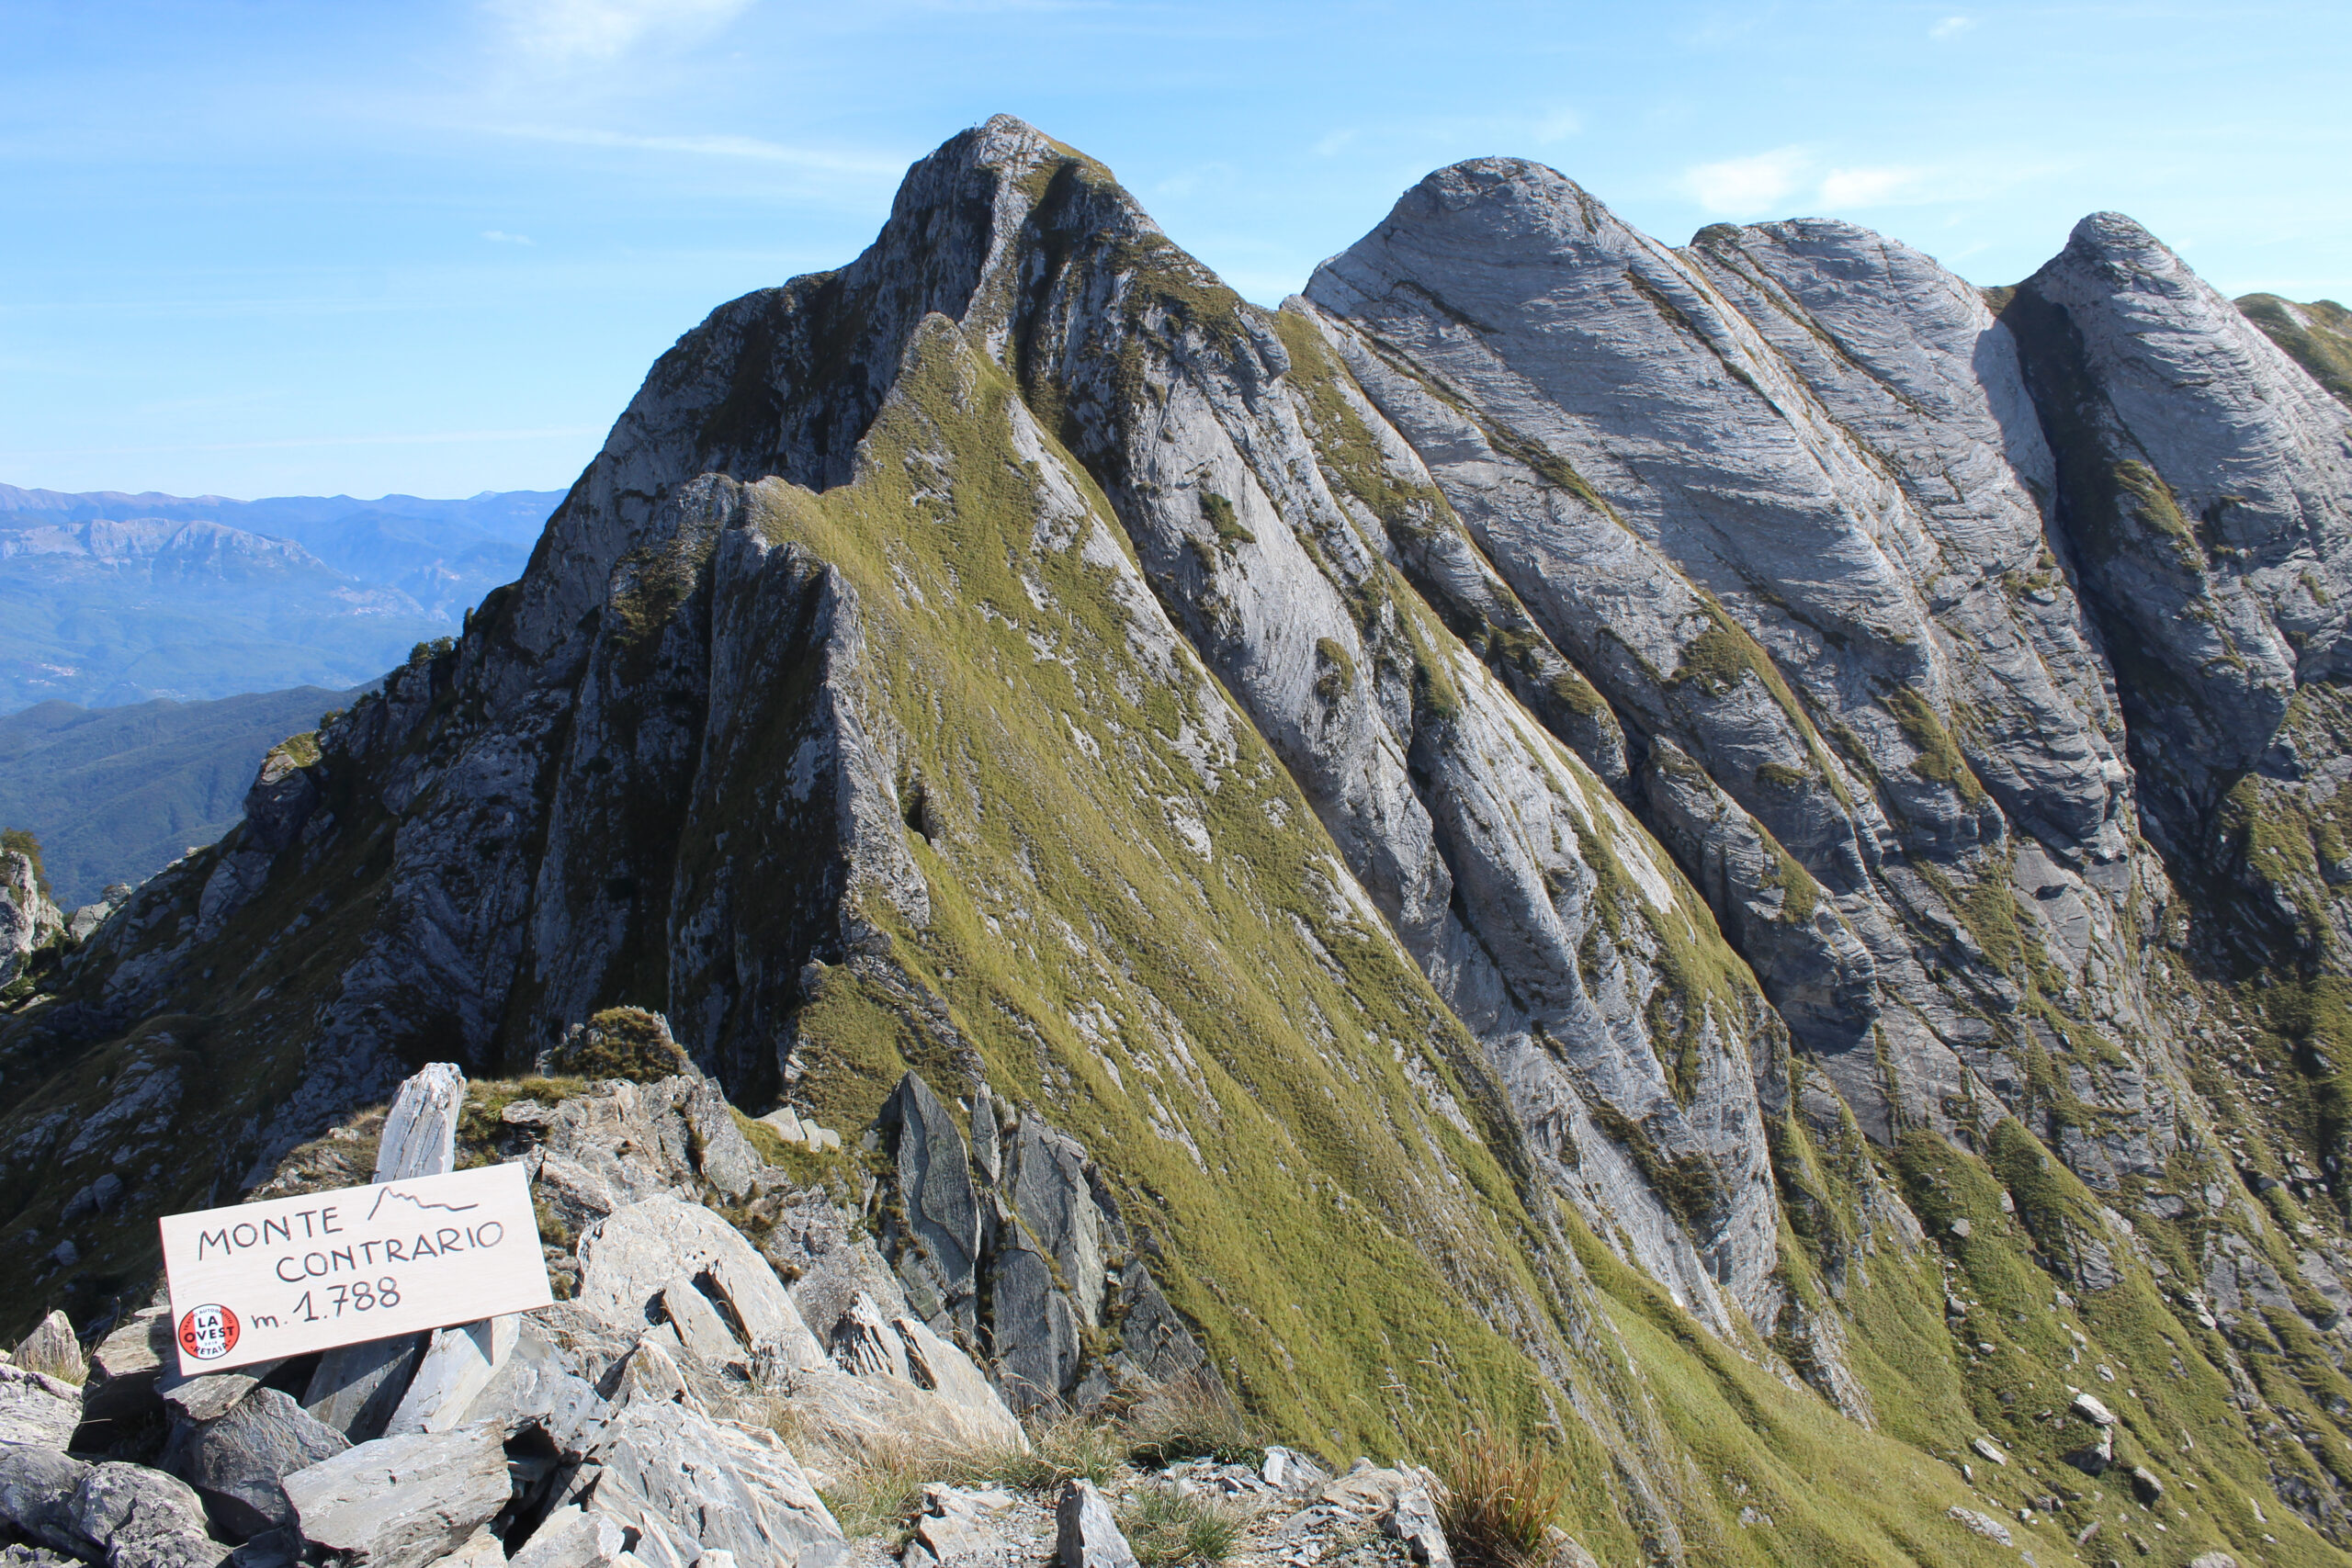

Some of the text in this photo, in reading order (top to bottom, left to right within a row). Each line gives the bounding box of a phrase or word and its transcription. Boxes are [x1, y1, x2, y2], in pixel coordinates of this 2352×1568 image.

[198, 1206, 344, 1261] MONTE
[276, 1221, 504, 1282] CONTRARIO
[198, 1315, 219, 1328] LA
[292, 1276, 401, 1323] 1.788
[184, 1325, 234, 1343] OVEST
